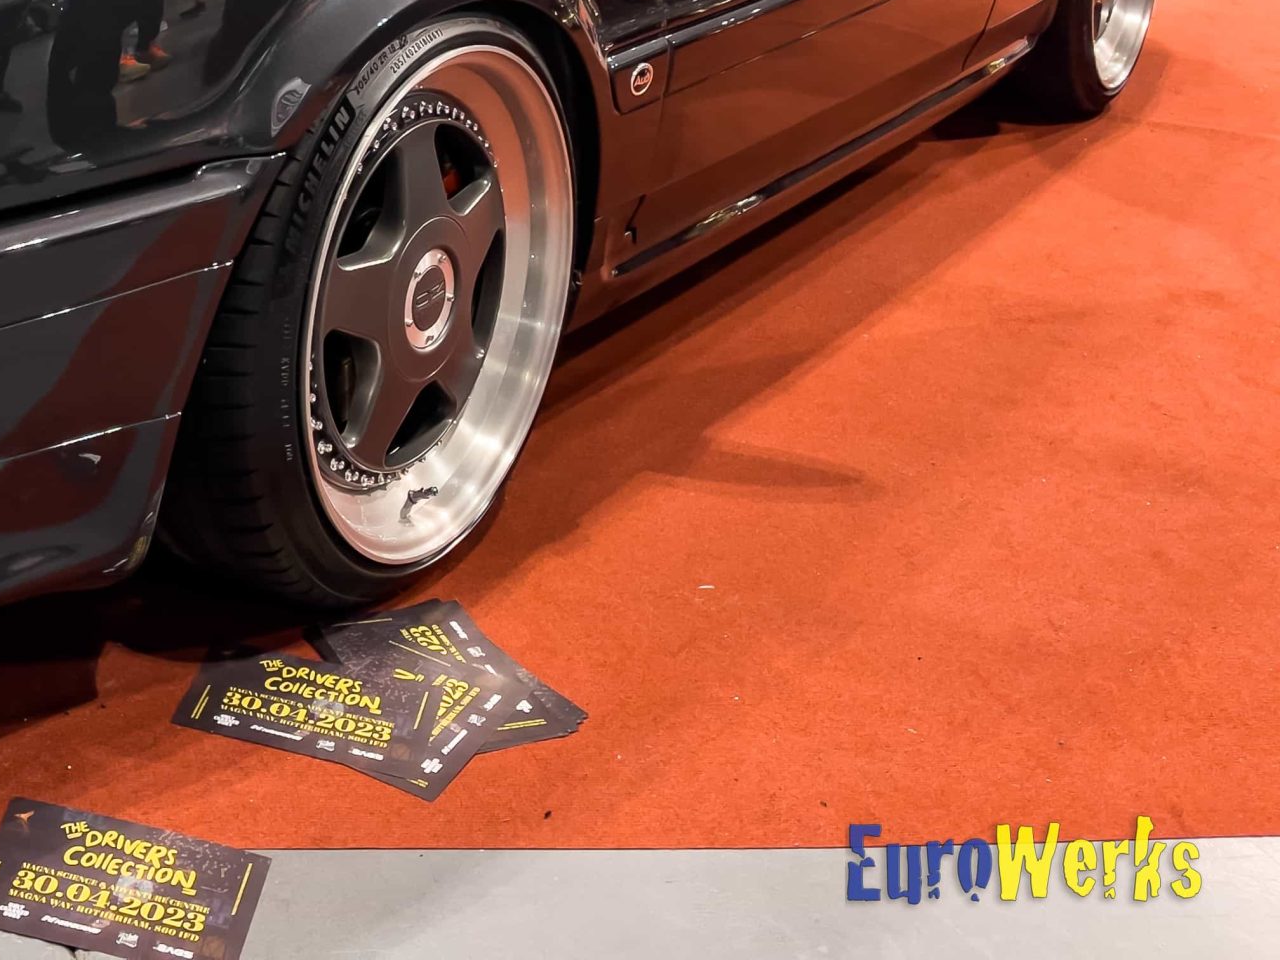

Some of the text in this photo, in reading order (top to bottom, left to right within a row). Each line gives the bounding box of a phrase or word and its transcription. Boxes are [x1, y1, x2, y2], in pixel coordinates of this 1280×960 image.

[285, 106, 352, 253] MICHELIN
[259, 659, 285, 669] THE
[282, 666, 363, 695] DRIVERS
[222, 691, 392, 741] 30.04.2023
[60, 821, 90, 834] THE
[85, 830, 178, 869] DRIVERS
[22, 862, 56, 876] MAGNA
[56, 870, 99, 887] SCIENCE
[8, 888, 47, 904] MAGNA
[11, 869, 206, 932] 30.04.2023
